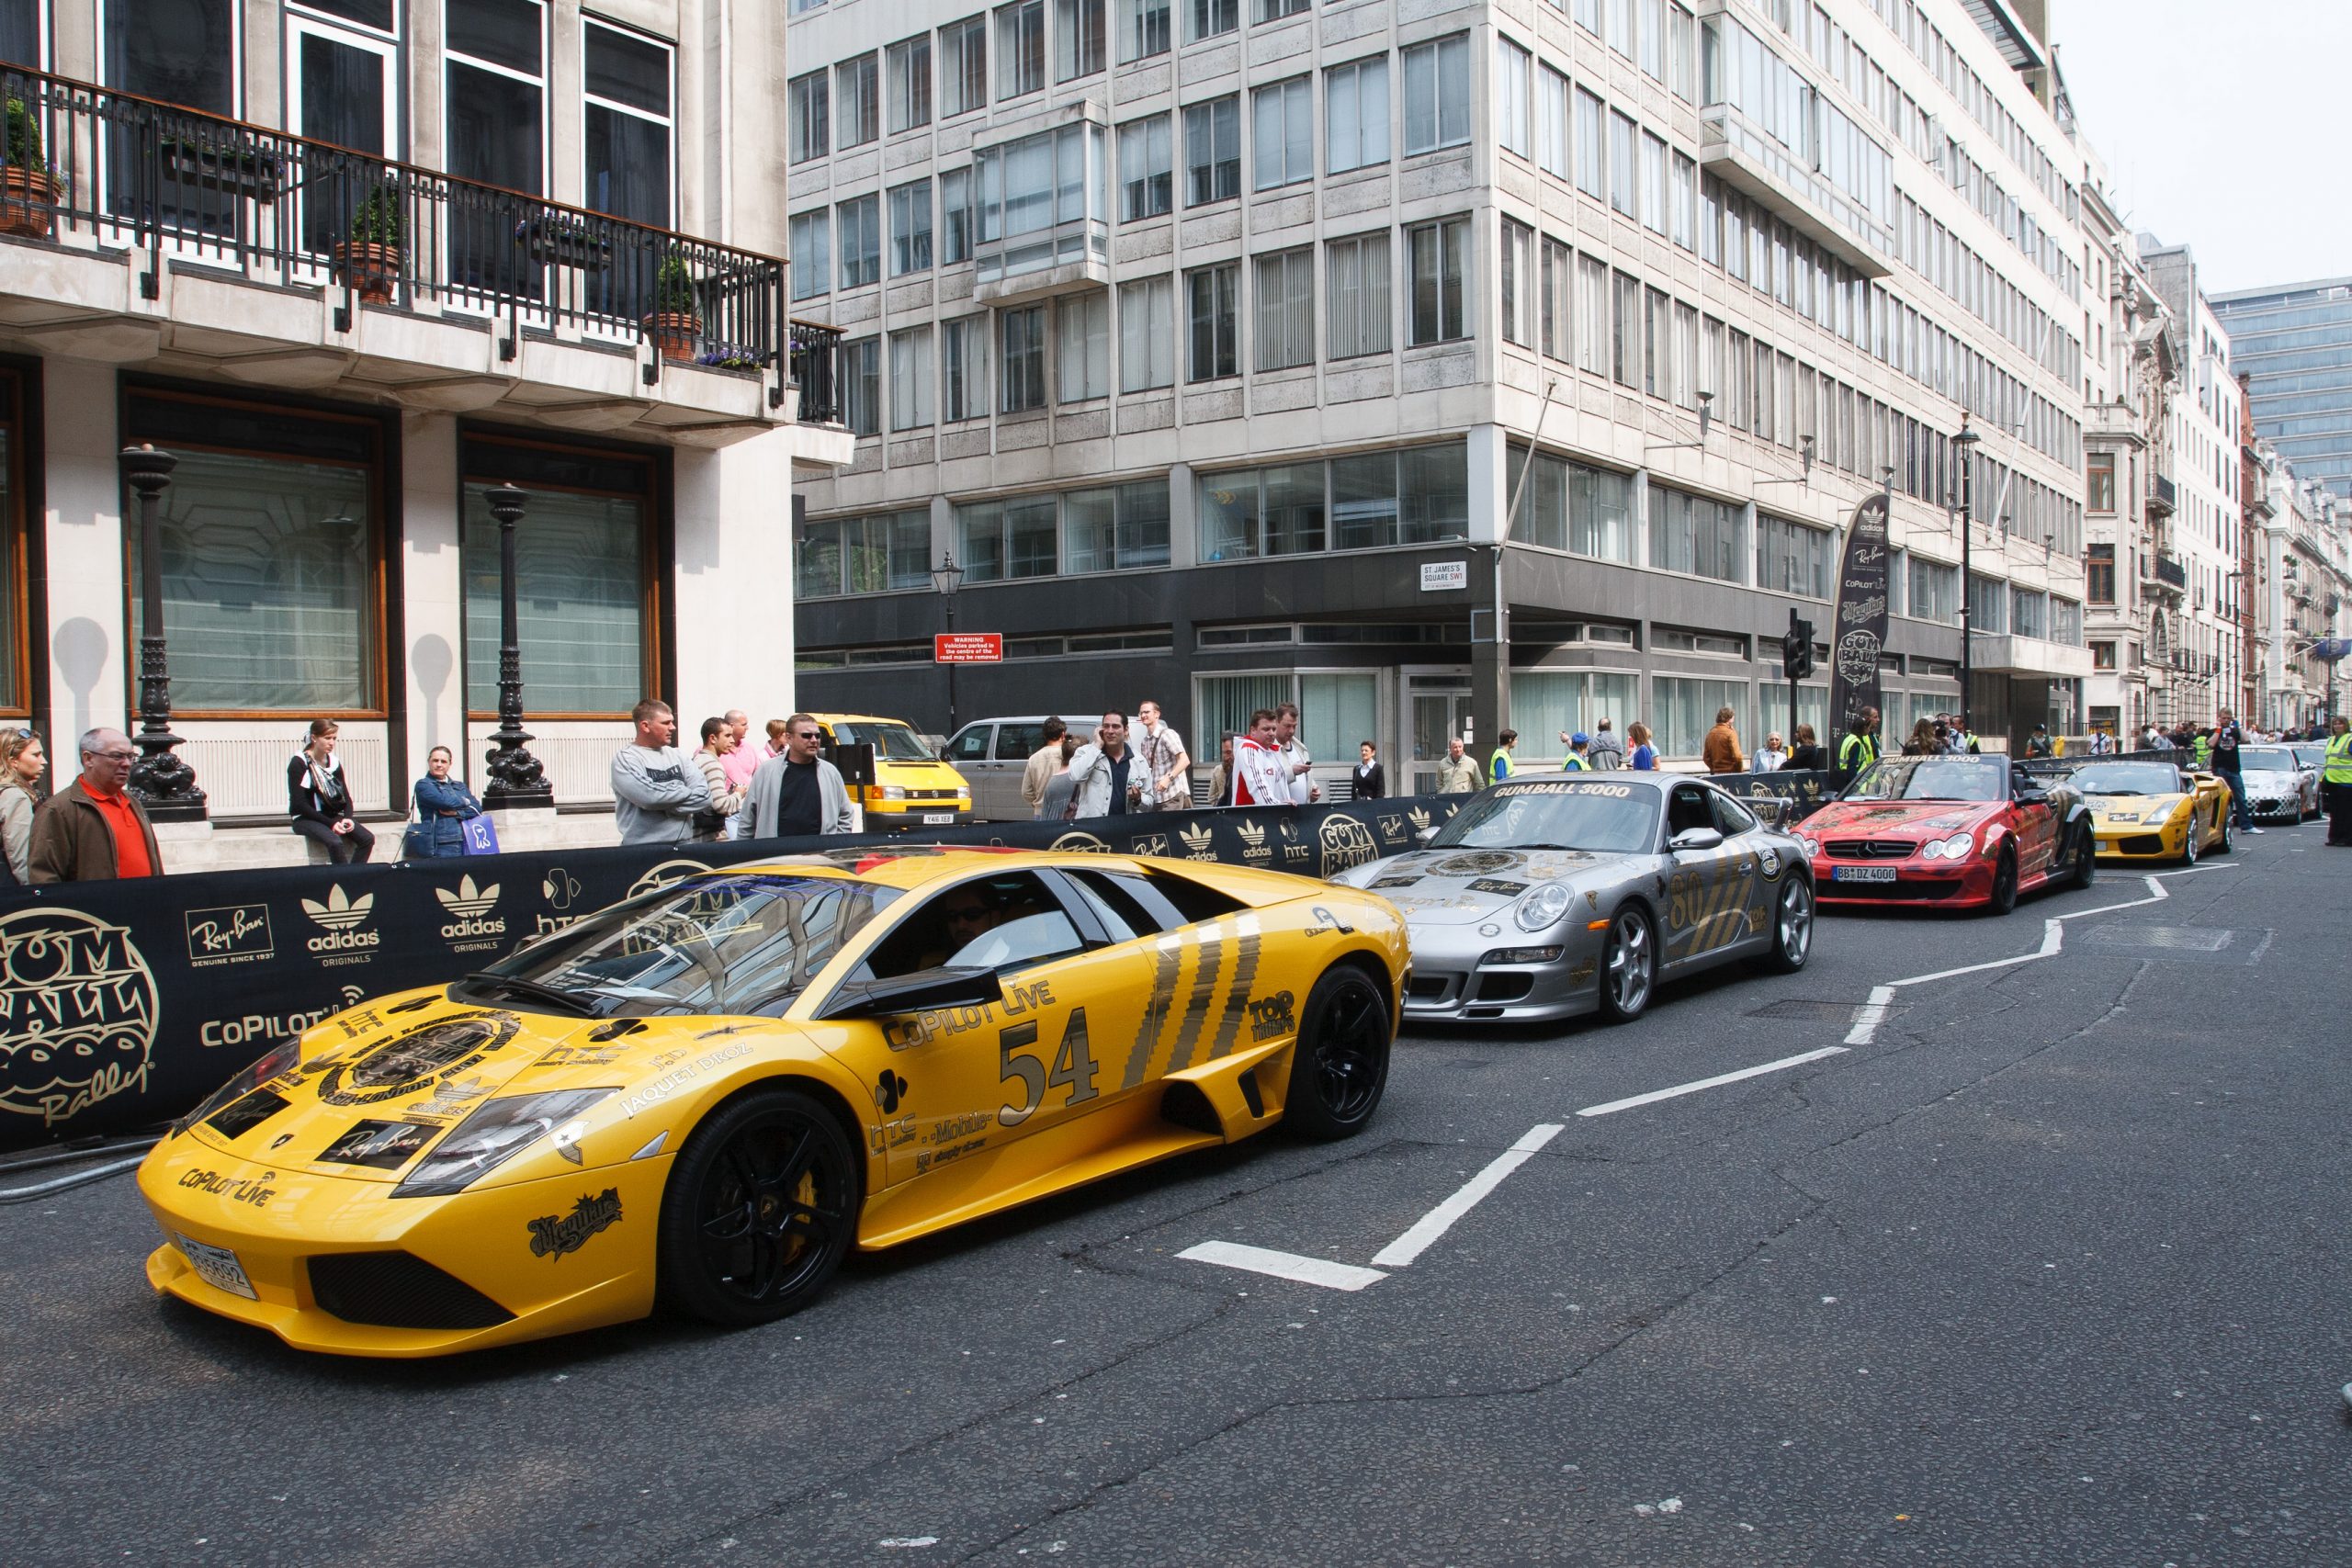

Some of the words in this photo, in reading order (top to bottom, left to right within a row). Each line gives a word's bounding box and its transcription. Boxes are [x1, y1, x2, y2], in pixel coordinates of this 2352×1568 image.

[1424, 573, 1449, 581] SQUARE
[1449, 572, 1463, 581] SW1
[1433, 564, 1461, 573] JAMES'S
[1943, 754, 1981, 763] 3000
[1494, 783, 1576, 798] GUMBALL
[1578, 783, 1631, 798] 3000
[1243, 844, 1272, 859] adidas
[1838, 867, 1850, 879] BB
[1857, 867, 1869, 879] DZ
[1871, 867, 1895, 880] 4000
[1669, 871, 1703, 931] 80
[191, 909, 264, 952] Ray-Ban
[441, 918, 505, 938] adidas
[307, 930, 380, 952] adidas
[454, 941, 499, 953] ORIGINALS
[191, 957, 228, 968] GENUINE
[230, 954, 254, 964] SINCE
[255, 953, 275, 961] 1937
[322, 954, 371, 967] ORIGINALS
[1248, 989, 1295, 1027] TOP
[1251, 1014, 1295, 1043] TRUMPS
[439, 1054, 486, 1080] 2007
[998, 1006, 1100, 1128] 54
[618, 1064, 697, 1121] JAQUET
[697, 1042, 754, 1071] DROZ
[39, 1061, 148, 1128] Rally
[406, 1101, 471, 1117] adidas
[335, 1125, 423, 1160] Ray-Ban
